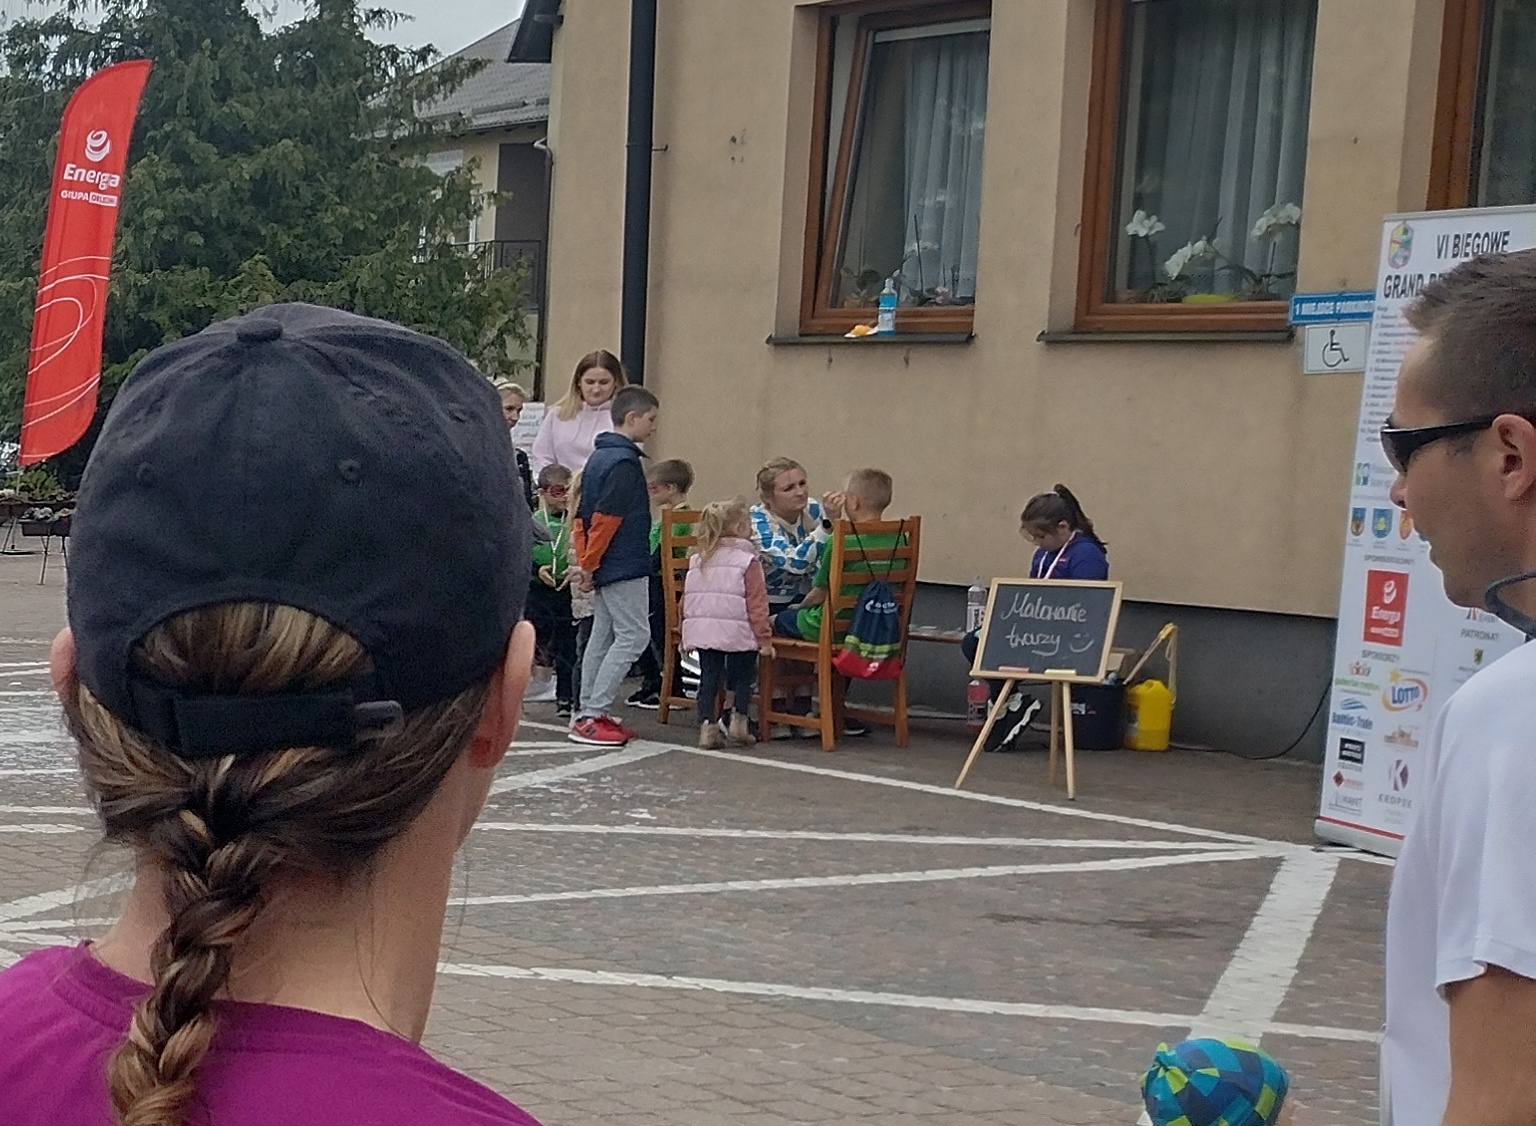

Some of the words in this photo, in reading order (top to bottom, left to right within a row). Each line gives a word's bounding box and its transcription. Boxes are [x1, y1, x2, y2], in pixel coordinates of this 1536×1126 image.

[63, 163, 121, 191] Energa
[1436, 234, 1449, 259] VI
[1451, 230, 1510, 258] BIEGOWE
[1383, 273, 1425, 299] GRAND
[1295, 303, 1301, 315] 1
[1000, 592, 1087, 622] Malowanie
[1006, 623, 1060, 656] twarzy
[1392, 685, 1420, 705] LOTTO
